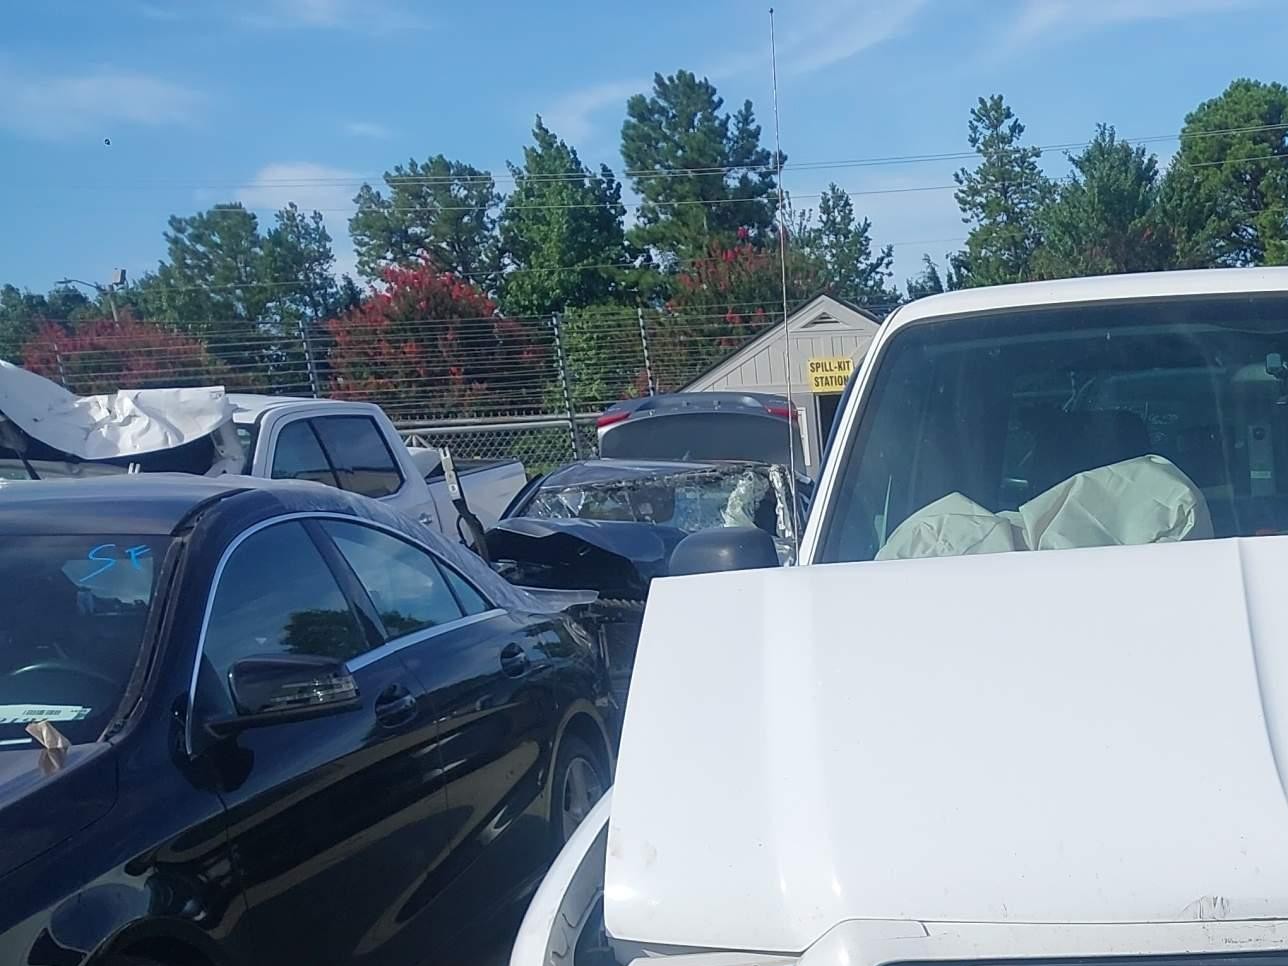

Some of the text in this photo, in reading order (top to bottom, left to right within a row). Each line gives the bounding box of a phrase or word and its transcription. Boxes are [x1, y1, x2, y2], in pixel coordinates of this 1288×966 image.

[809, 360, 851, 373] SPILL-KIT
[814, 375, 849, 387] STATION
[79, 543, 152, 583] SF
